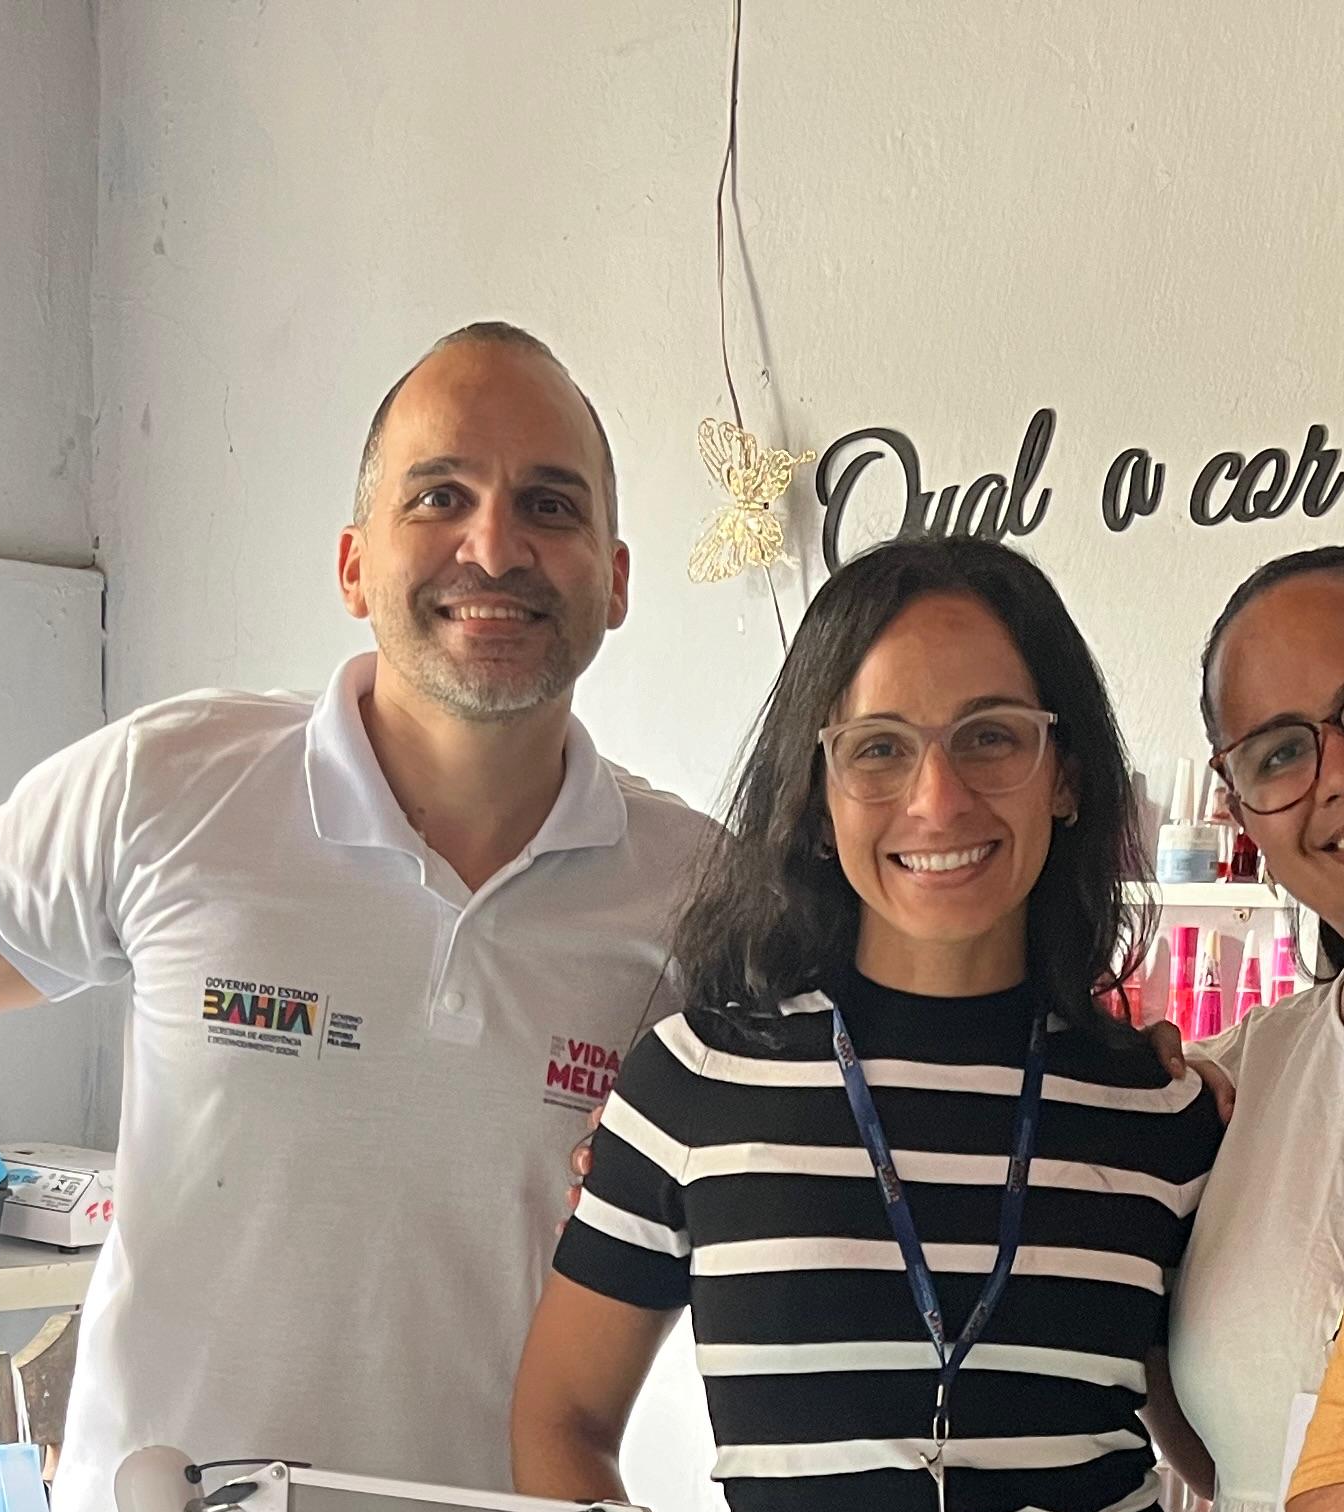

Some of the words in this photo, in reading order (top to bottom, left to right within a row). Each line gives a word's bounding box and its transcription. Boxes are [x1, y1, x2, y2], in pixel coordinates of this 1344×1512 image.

[1102, 447, 1165, 532] a
[205, 977, 256, 994] GOVERNO
[258, 984, 276, 996] DO
[277, 986, 319, 1003] ESTADO
[203, 988, 313, 1036] BAHIA
[568, 1038, 620, 1074] VIDA
